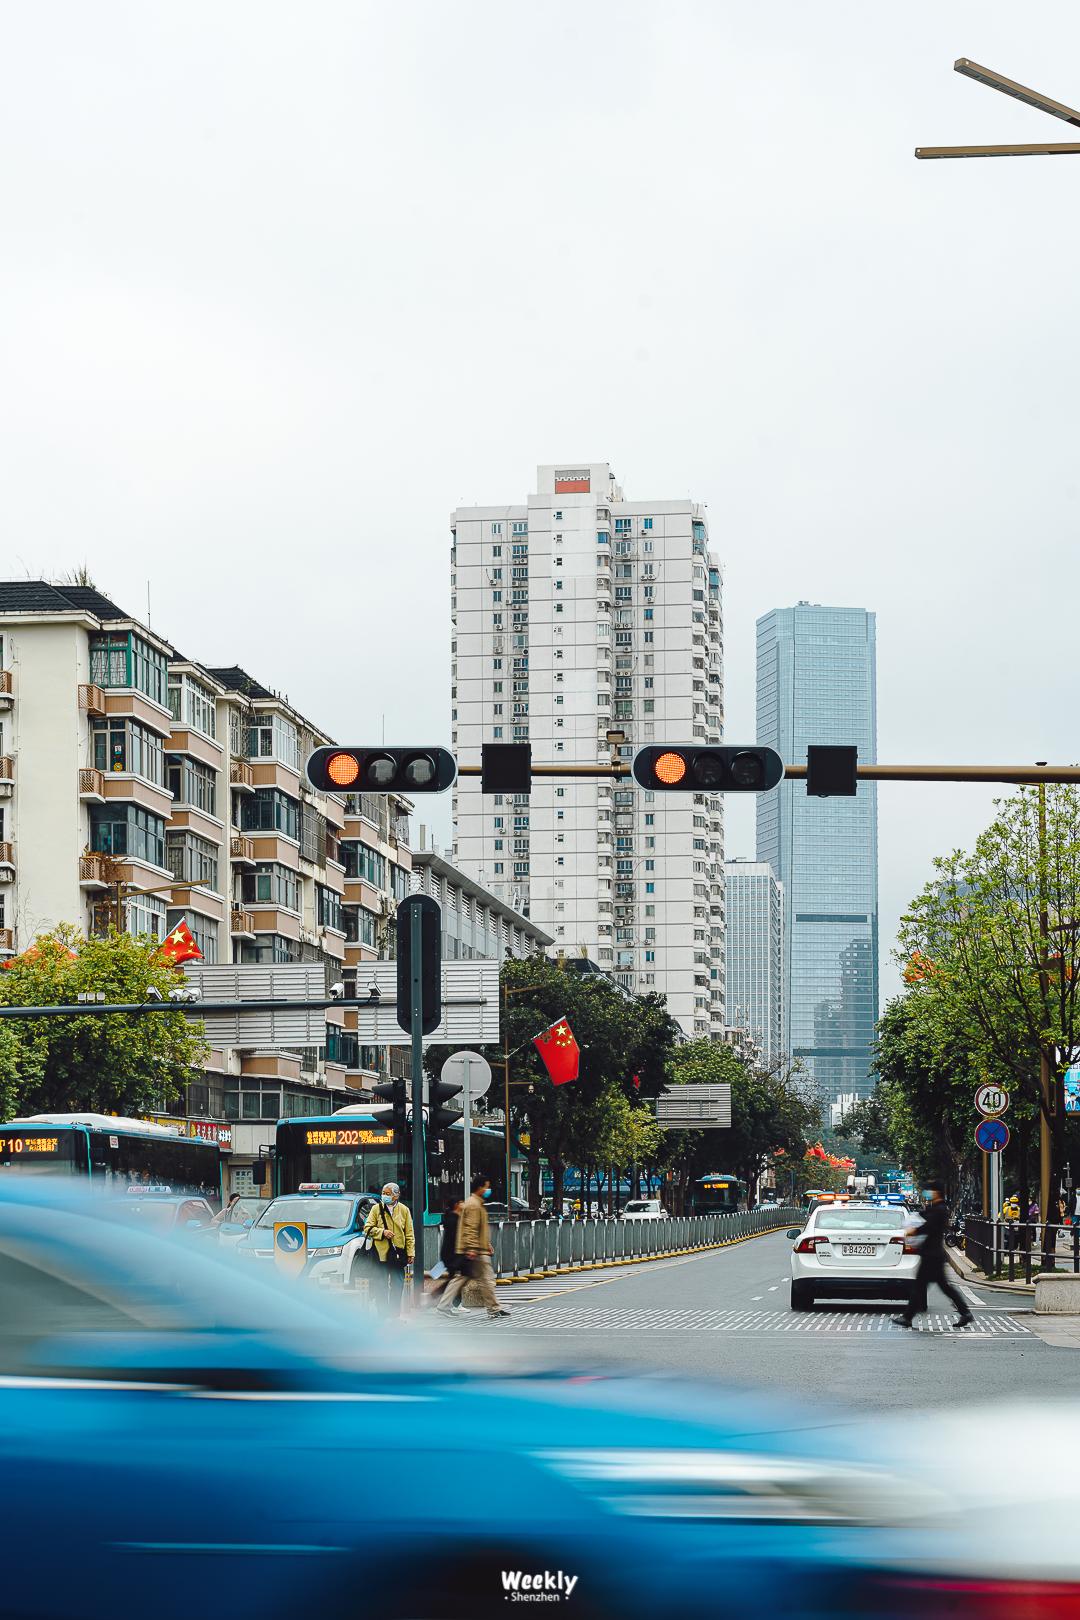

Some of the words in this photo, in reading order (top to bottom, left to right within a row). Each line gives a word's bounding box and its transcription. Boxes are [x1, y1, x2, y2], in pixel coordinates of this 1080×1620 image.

[982, 1091, 1001, 1108] 40
[338, 1130, 359, 1145] 202
[7, 1138, 23, 1153] 10
